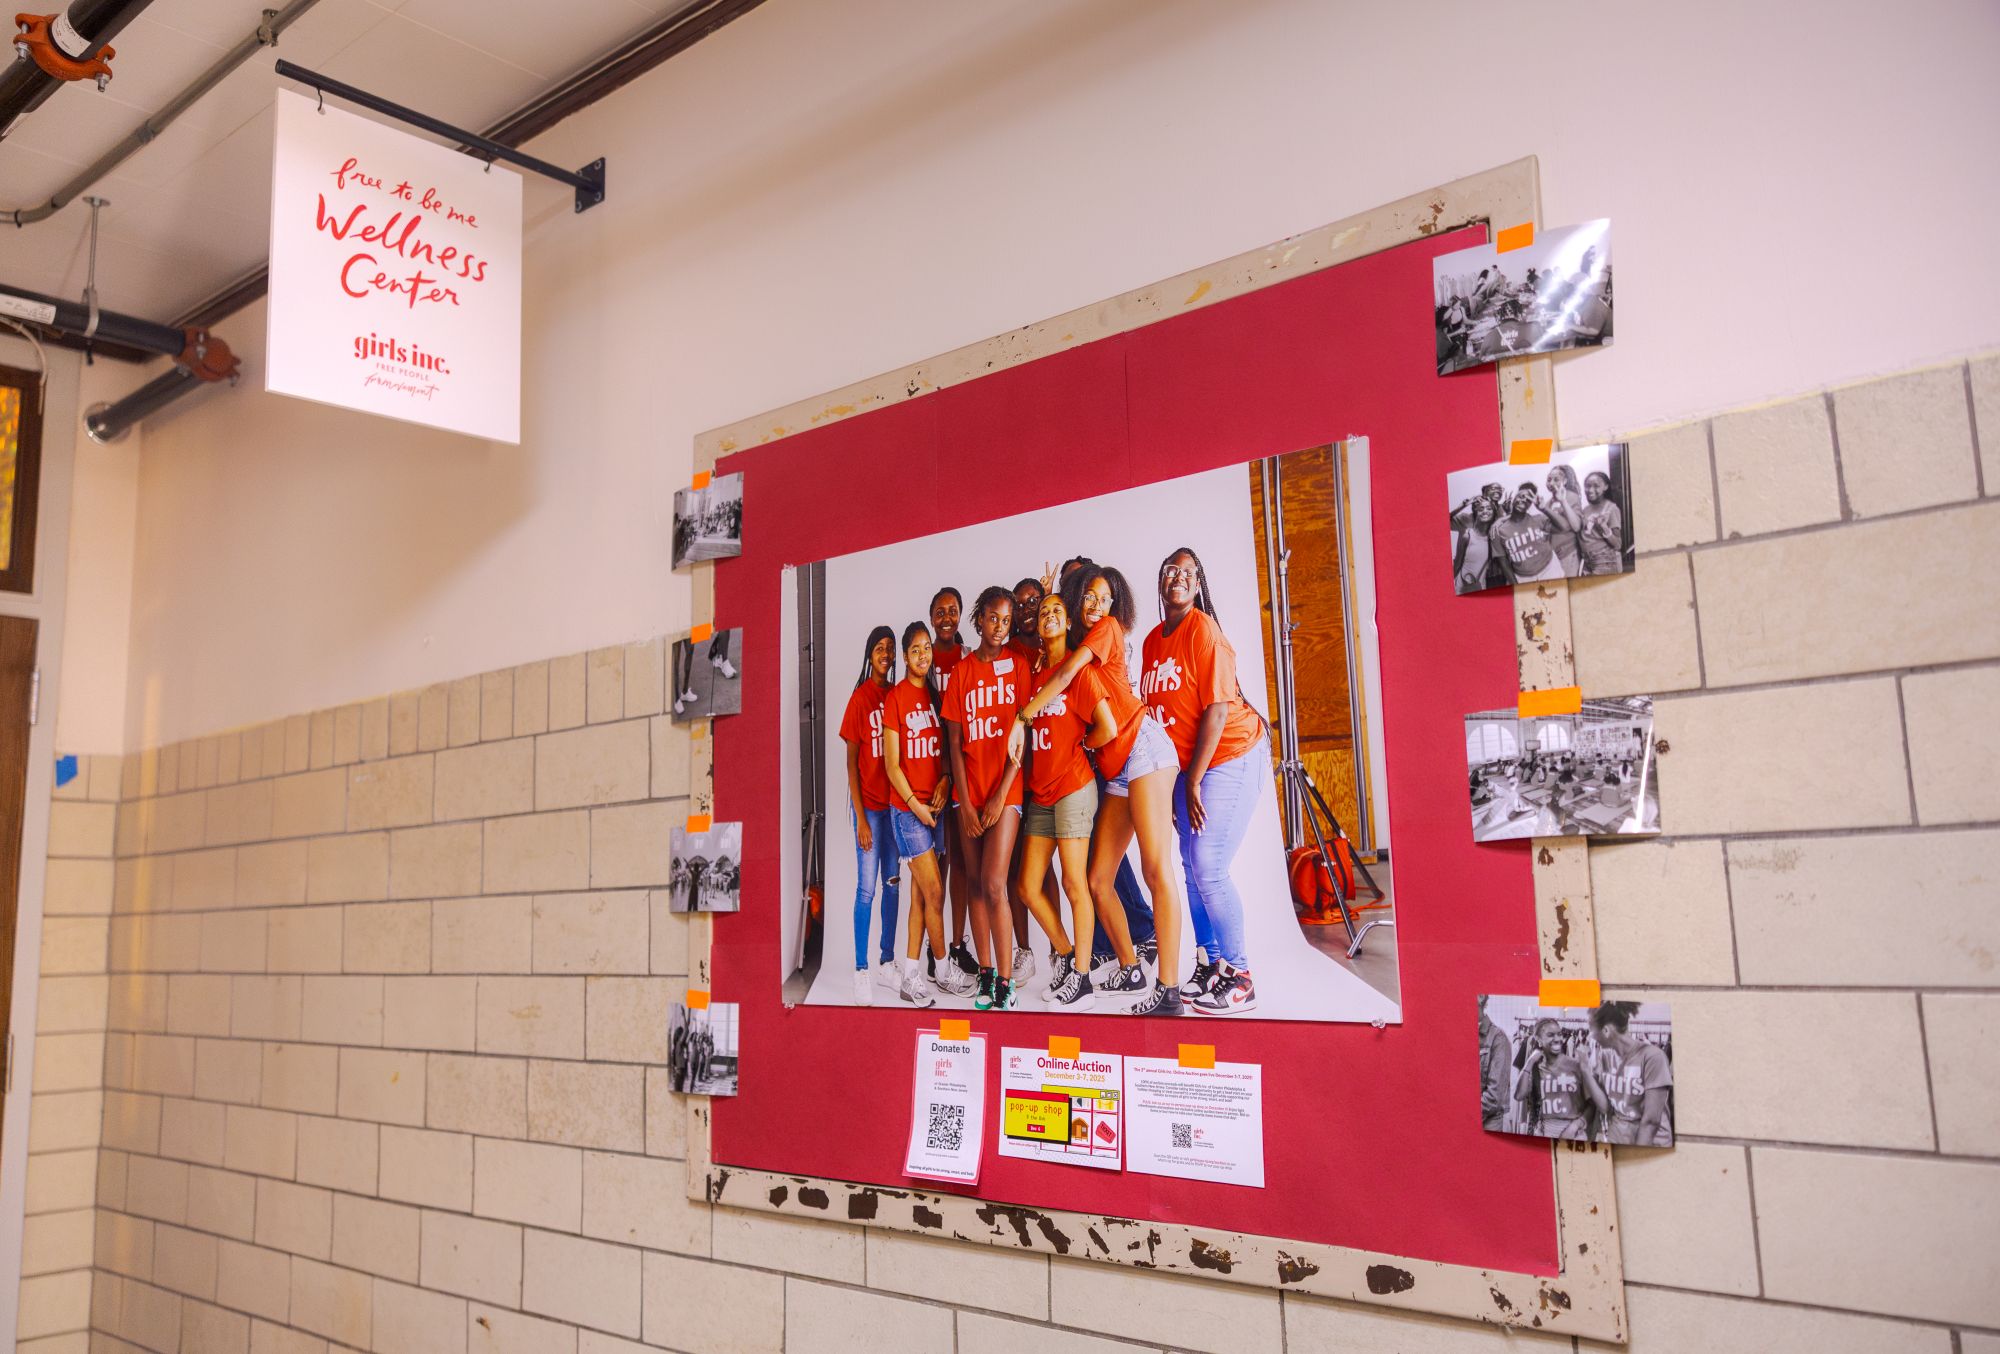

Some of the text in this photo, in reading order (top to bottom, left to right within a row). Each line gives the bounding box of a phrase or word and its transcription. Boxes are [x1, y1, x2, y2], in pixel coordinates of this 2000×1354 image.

[331, 158, 479, 228] free to be me
[316, 193, 488, 282] Wellness
[340, 253, 460, 309] Center
[354, 332, 450, 375] girls inc.
[376, 362, 430, 382] FREE PEOPLE
[965, 677, 1015, 721] girls
[968, 715, 1003, 743] inc.
[931, 1042, 971, 1054] Donate to
[935, 1058, 952, 1070] girls
[1037, 1057, 1112, 1073] Online Auction
[1045, 1070, 1075, 1080] December
[1090, 1075, 1106, 1083] 2025
[1010, 1102, 1039, 1114] pop-up
[1043, 1104, 1063, 1117] shop
